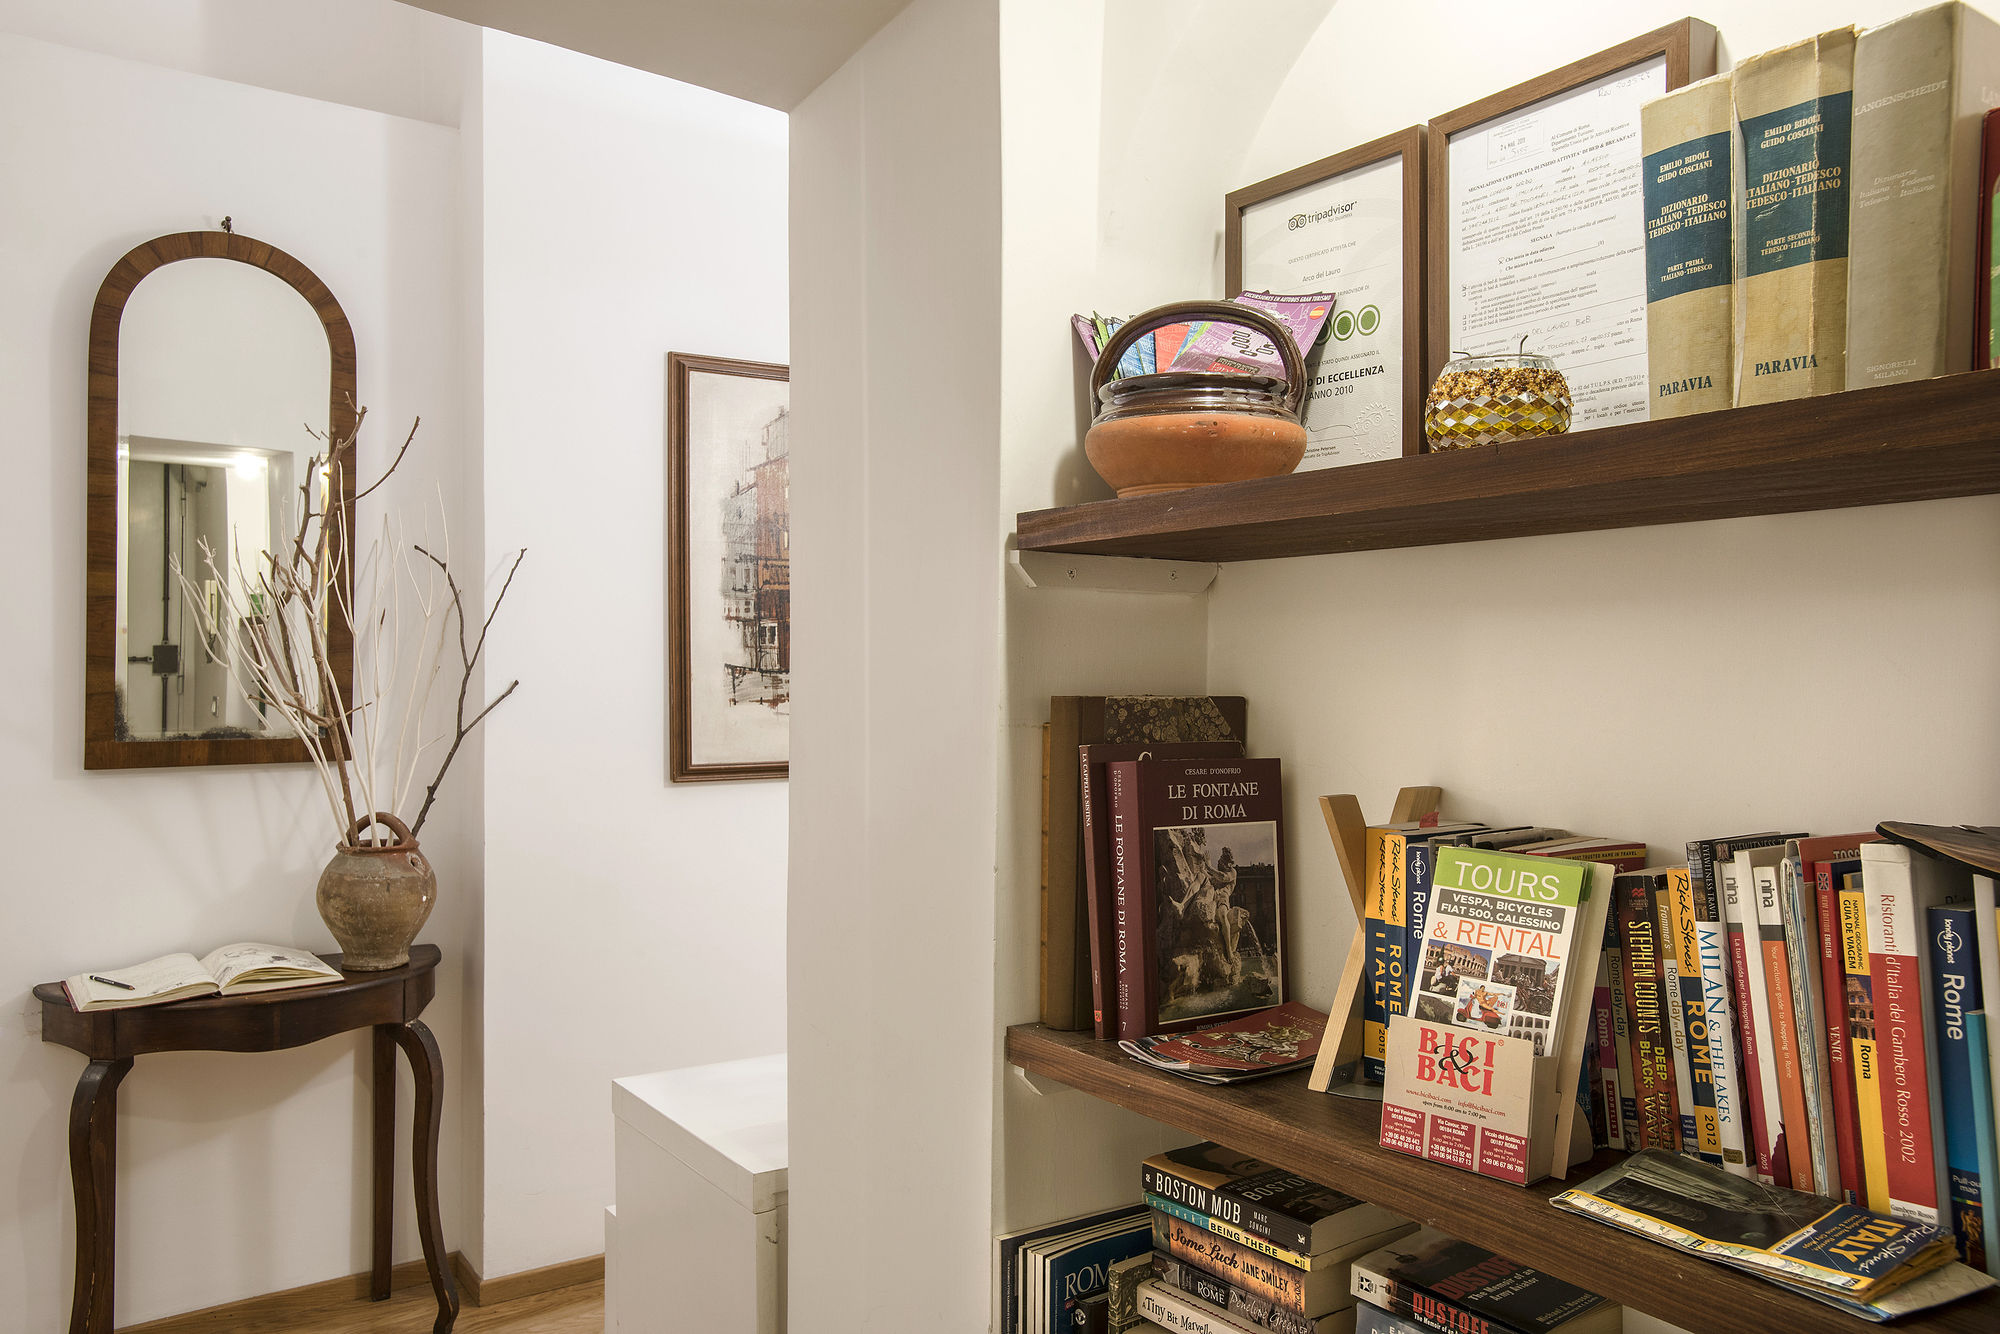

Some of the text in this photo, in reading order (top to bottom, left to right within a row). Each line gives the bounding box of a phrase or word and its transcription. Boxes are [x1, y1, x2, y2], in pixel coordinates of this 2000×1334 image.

[1854, 79, 1948, 117] LANGENSCHEIDT
[1760, 124, 1824, 149] GUIDO COSCIANI
[1764, 114, 1821, 139] EMILIO BIDOLI
[1657, 160, 1713, 184] GUIDO COSCIANI
[1660, 150, 1710, 173] EMILIO BIDOLI
[1763, 160, 1820, 184] DIZIONARIO
[1745, 178, 1841, 210] TEDESCO-ITALIANO
[1746, 166, 1841, 199] ITALIANO-TEDESCO
[1308, 202, 1355, 223] tripadvisor
[1648, 199, 1727, 230] ITALIANO-TEDESCO
[1661, 193, 1708, 216] DIZIONARIO
[1648, 210, 1727, 239] TEDESCO-ITALIANO
[1761, 235, 1820, 256] TEDESCO-ITALIANO
[1766, 235, 1786, 247] PARTE
[1315, 271, 1325, 279] del
[1325, 267, 1341, 277] Lauro
[1661, 263, 1713, 283] ITALIANO-TEDESCO
[1667, 258, 1705, 274] PARTE PRIMA
[1316, 376, 1325, 386] DI
[1328, 364, 1385, 384] ECCELLENZA
[1755, 354, 1819, 377] PARAVIA
[1866, 358, 1917, 374] SIGNORELLI
[1874, 369, 1909, 380] MILANO
[1335, 384, 1354, 397] 2010
[1659, 375, 1713, 398] PARAVIA
[1082, 753, 1088, 763] LA
[1184, 767, 1241, 776] CESARE D'ONOFRIO
[1167, 782, 1259, 799] LE FONTANE
[1115, 814, 1123, 833] LE
[1182, 804, 1247, 820] DI ROMA
[1115, 837, 1126, 906] FONTANE
[1391, 839, 1401, 874] Rick
[1455, 861, 1560, 901] TOURS
[1674, 873, 1690, 917] Rick
[1702, 844, 1717, 919] EYEWITNESS TRAVEL
[1725, 877, 1738, 905] nina
[1760, 879, 1775, 908] nina
[1118, 910, 1126, 926] DI
[1412, 891, 1426, 940] Rome
[1441, 903, 1561, 931] FIAT 500, CALESSINO
[1453, 893, 1553, 918] VESPA, BICYCLES
[1433, 919, 1561, 959] & RENTAL
[1660, 903, 1672, 952] Frommer's
[1843, 899, 1856, 969] GUIA DE VIAGEM
[1852, 900, 1864, 970] NATIONAL GEOGRAPHIC
[1943, 918, 1955, 964] lonely planet
[1118, 930, 1127, 975] ROMA
[1824, 933, 1832, 959] ENGLISH
[1389, 944, 1402, 1014] ROME
[1628, 921, 1662, 1034] STEPHEN COONTS
[1610, 955, 1627, 1038] Rome day day
[1666, 967, 1686, 1052] Rome day day
[1942, 973, 1966, 1040] Rome
[1122, 1021, 1127, 1032] 7
[1597, 1008, 1610, 1047] Rome
[1698, 929, 1732, 1123] MILAN & THE LAKES
[1741, 1000, 1752, 1030] shopping
[1880, 894, 1916, 1164] Ristoranti d'Italia del Gambero Rosso 2002
[1378, 1029, 1386, 1054] 2015
[1418, 1027, 1497, 1068] BICI
[1686, 1000, 1714, 1084] ROME
[1829, 1026, 1843, 1063] VENICE
[1434, 1044, 1474, 1074] &
[1639, 1041, 1654, 1089] BLACK:
[1654, 1046, 1668, 1081] DEEP
[1860, 1044, 1872, 1080] Roma
[1416, 1055, 1494, 1096] BACI
[1405, 1089, 1506, 1117] www.bicibaci.com info@bicibaci.com
[1606, 1084, 1618, 1136] SHORTLIST
[1704, 1113, 1717, 1146] 2012
[1952, 1174, 1982, 1188] Pull-ou
[1960, 1185, 1979, 1195] map
[1156, 1172, 1241, 1224] BOSTON MOB
[1890, 1204, 1936, 1220] Gambero Rosso
[1248, 1220, 1271, 1236] SONGINI
[1253, 1211, 1268, 1224] MARC
[1210, 1222, 1279, 1258] BEING THERE
[1828, 1219, 1908, 1263] ITALY
[1902, 1222, 1939, 1244] Rick
[1170, 1227, 1289, 1293] Some Luck JANE SMILEY
[1197, 1281, 1226, 1305] ROME
[1468, 1268, 1536, 1301] The Memoir of an
[1489, 1277, 1540, 1302] Army Aviator
[1145, 1297, 1166, 1323] Tiny
[1167, 1310, 1179, 1325] Bit
[1180, 1314, 1214, 1334] Marvello
[1413, 1292, 1489, 1334] DUSTOFF
